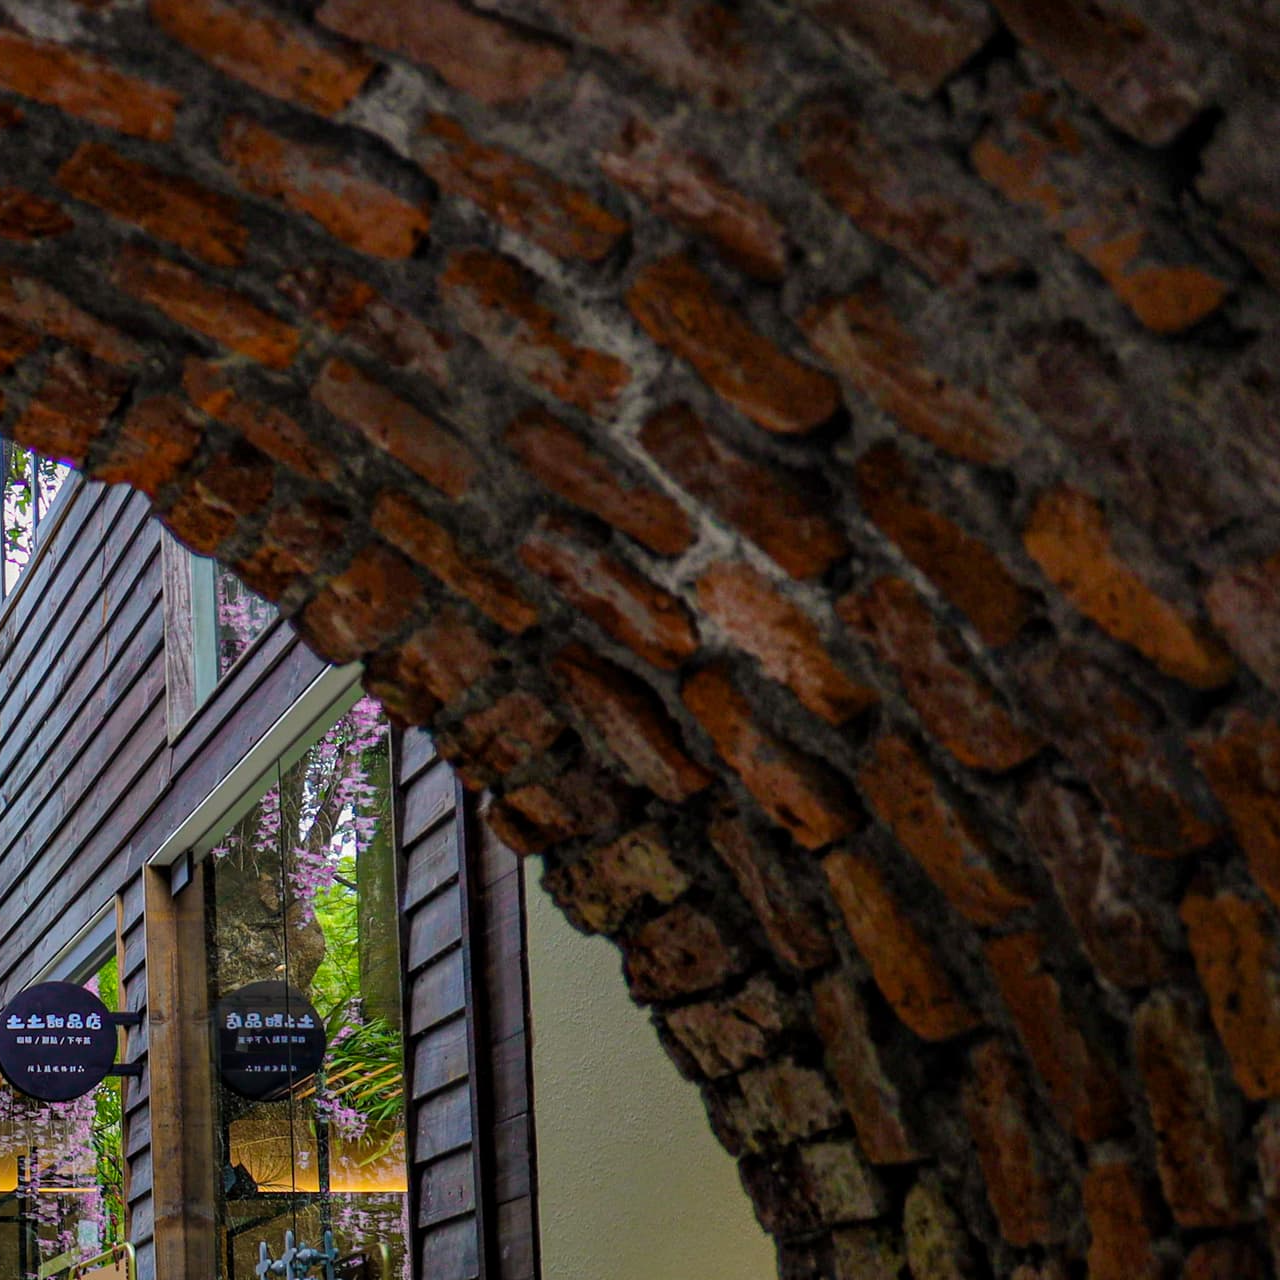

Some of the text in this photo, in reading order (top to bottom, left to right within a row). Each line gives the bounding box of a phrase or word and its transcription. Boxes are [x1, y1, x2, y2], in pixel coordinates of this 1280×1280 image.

[6, 1013, 102, 1030] 土土甜品店
